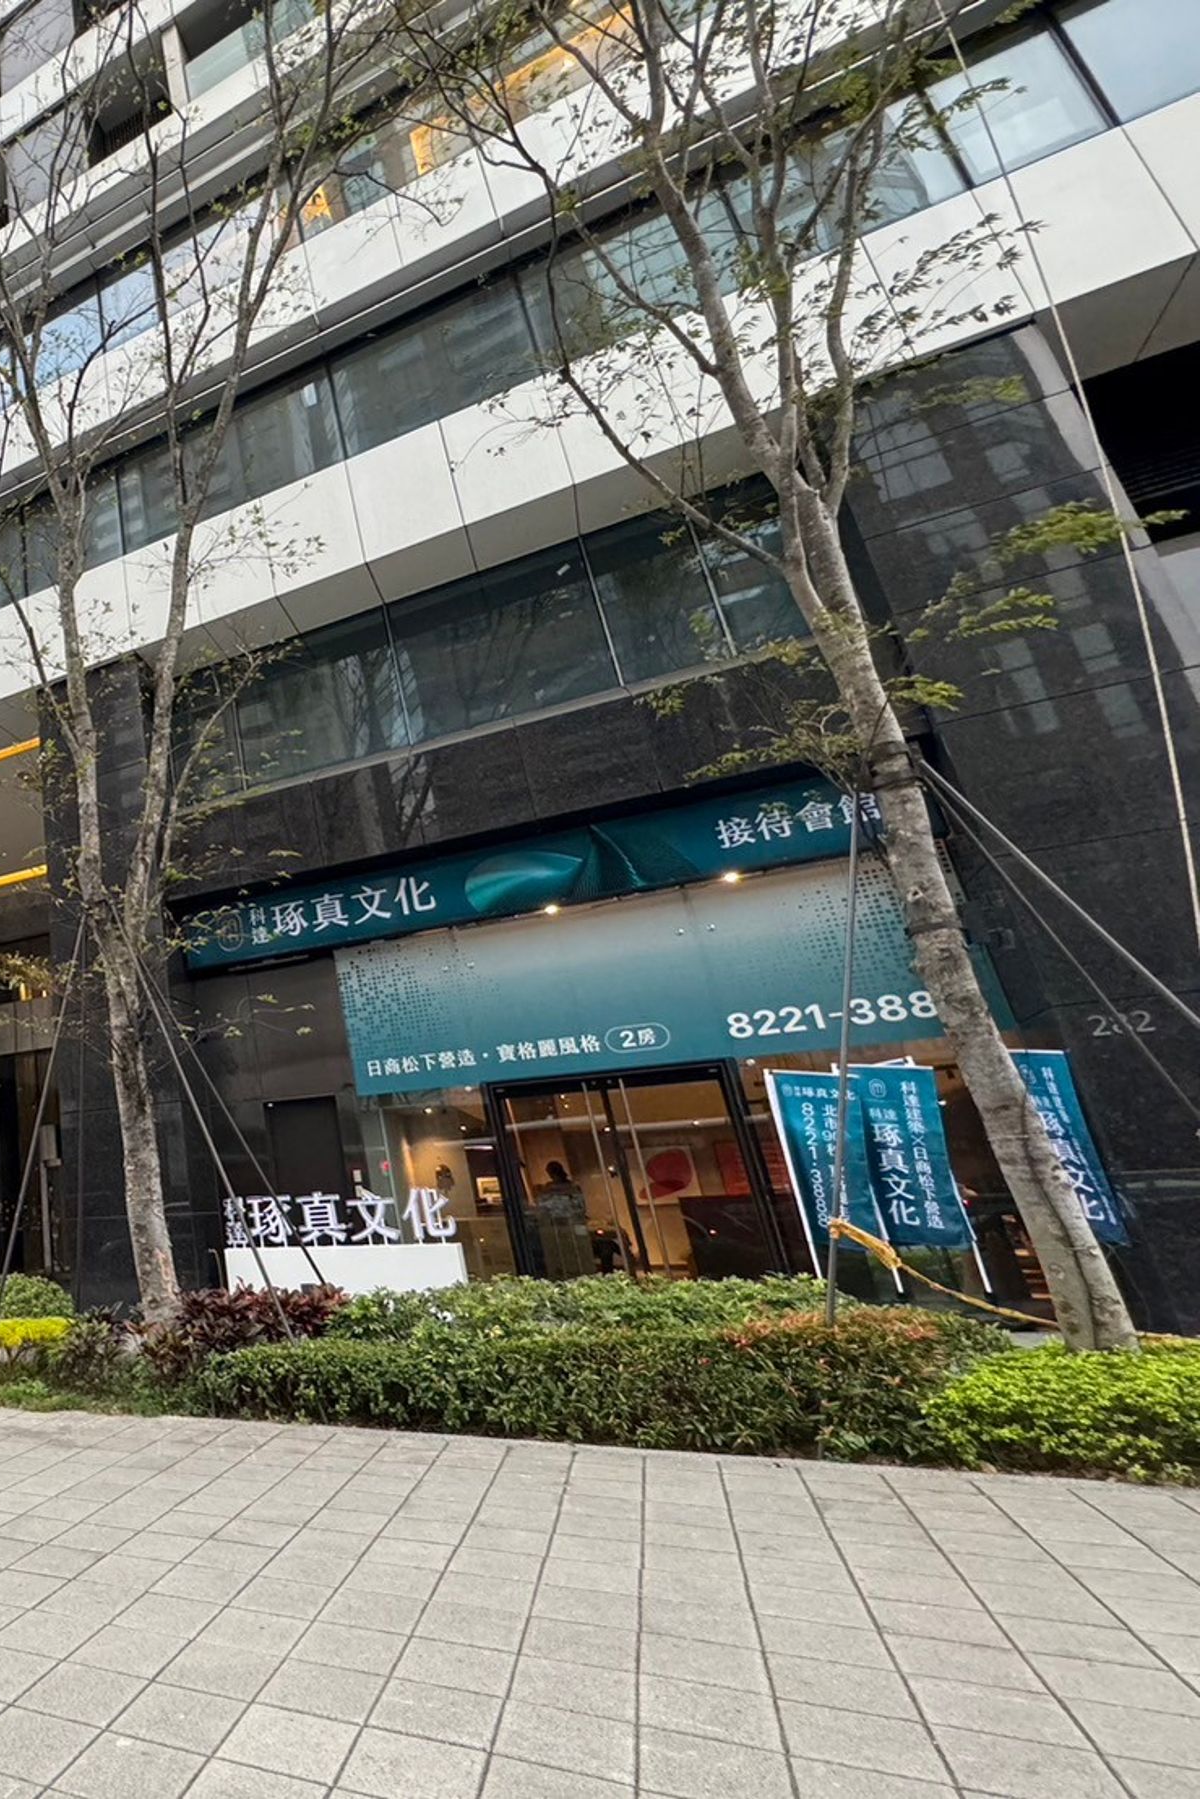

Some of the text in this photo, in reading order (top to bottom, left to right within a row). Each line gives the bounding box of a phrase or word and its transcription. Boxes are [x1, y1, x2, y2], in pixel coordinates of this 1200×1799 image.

[714, 791, 882, 849] 接待會館
[270, 876, 437, 938] 琢真文化
[619, 1026, 657, 1049] 2房
[726, 989, 938, 1039] 8221-388
[872, 1122, 921, 1226] 琢真文化
[246, 1187, 457, 1244] 琢真文化
